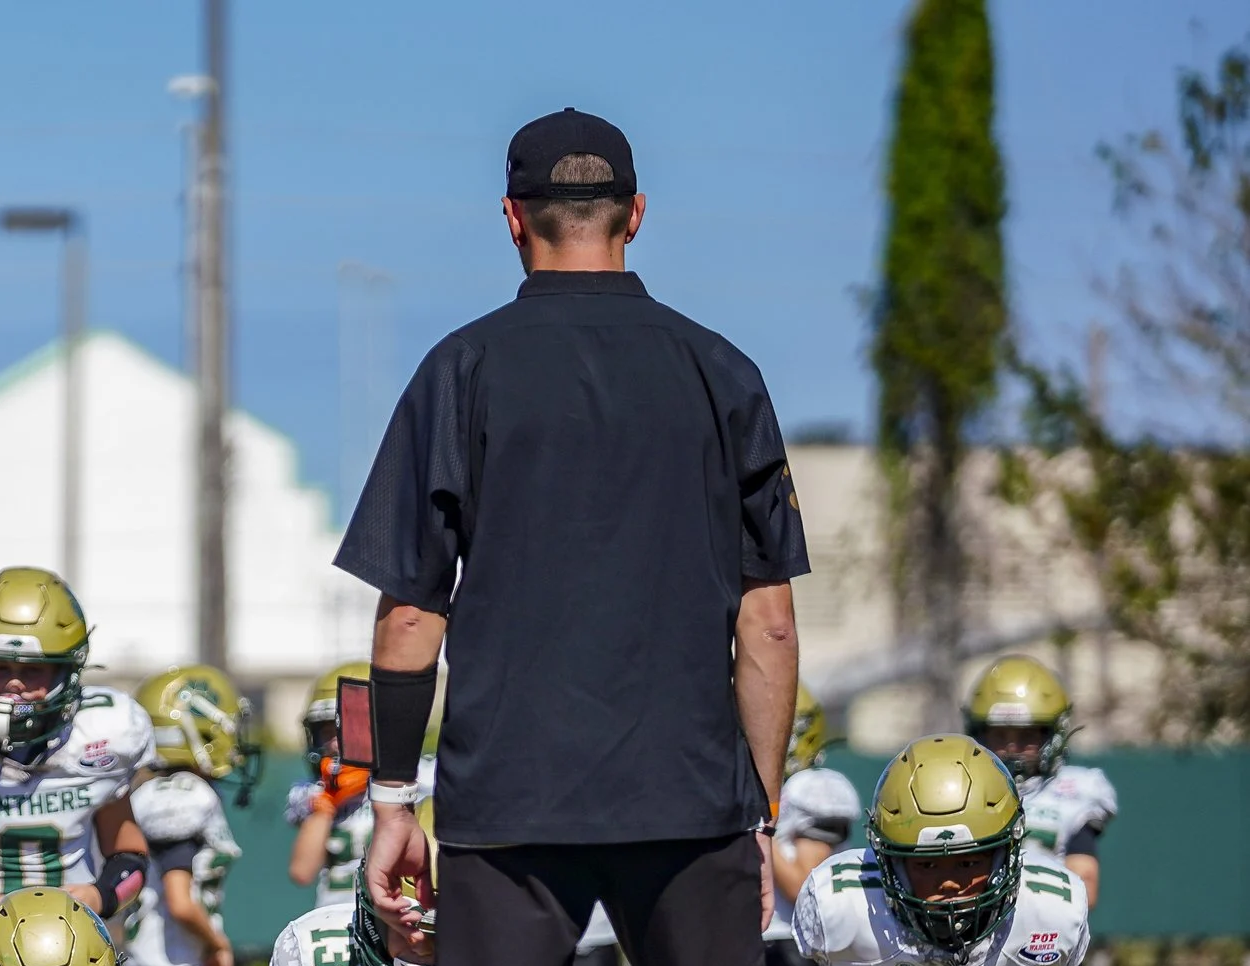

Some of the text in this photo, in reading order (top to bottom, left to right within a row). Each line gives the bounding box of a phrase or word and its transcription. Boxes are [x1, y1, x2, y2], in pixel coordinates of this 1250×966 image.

[831, 862, 885, 894] 11
[1024, 864, 1072, 904] 11
[1030, 932, 1058, 943] POP
